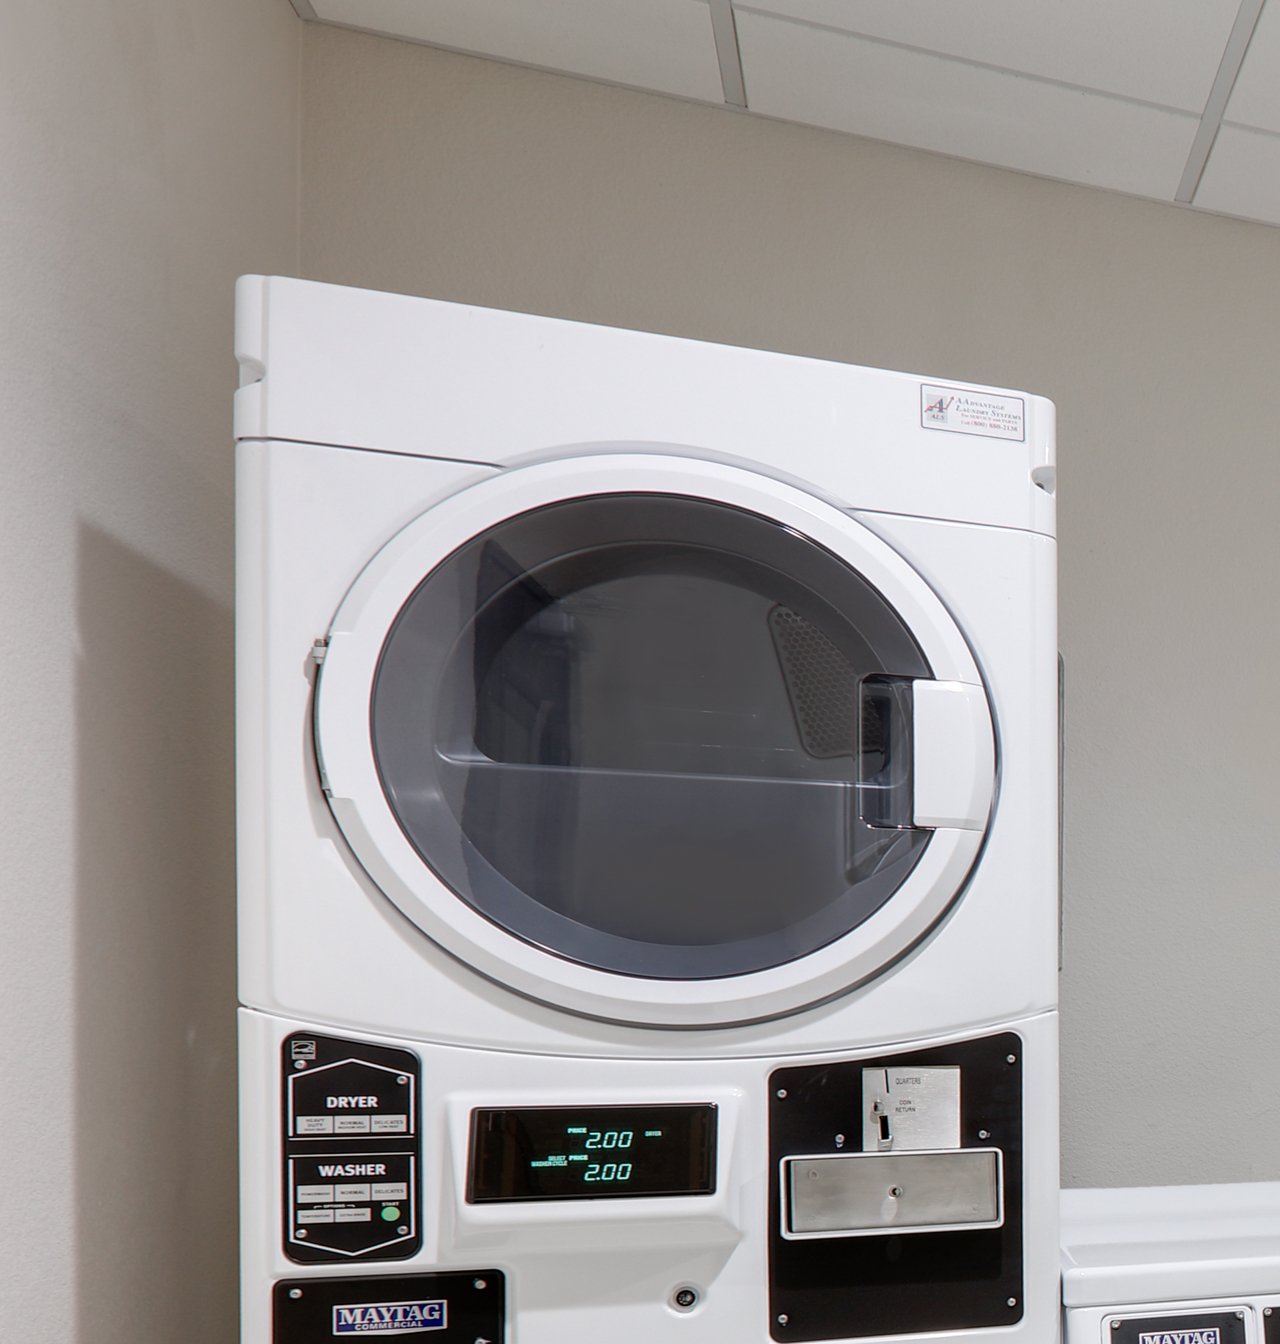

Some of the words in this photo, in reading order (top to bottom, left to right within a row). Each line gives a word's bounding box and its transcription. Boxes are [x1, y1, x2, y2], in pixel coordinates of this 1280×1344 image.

[895, 1077, 921, 1085] QUARTERS
[326, 1096, 378, 1108] DRYER
[585, 1131, 634, 1149] 2.00
[318, 1164, 386, 1177] WASHER
[584, 1163, 632, 1181] 2.00
[338, 1304, 441, 1325] MAYTAG
[354, 1320, 424, 1331] COMMERCIAL
